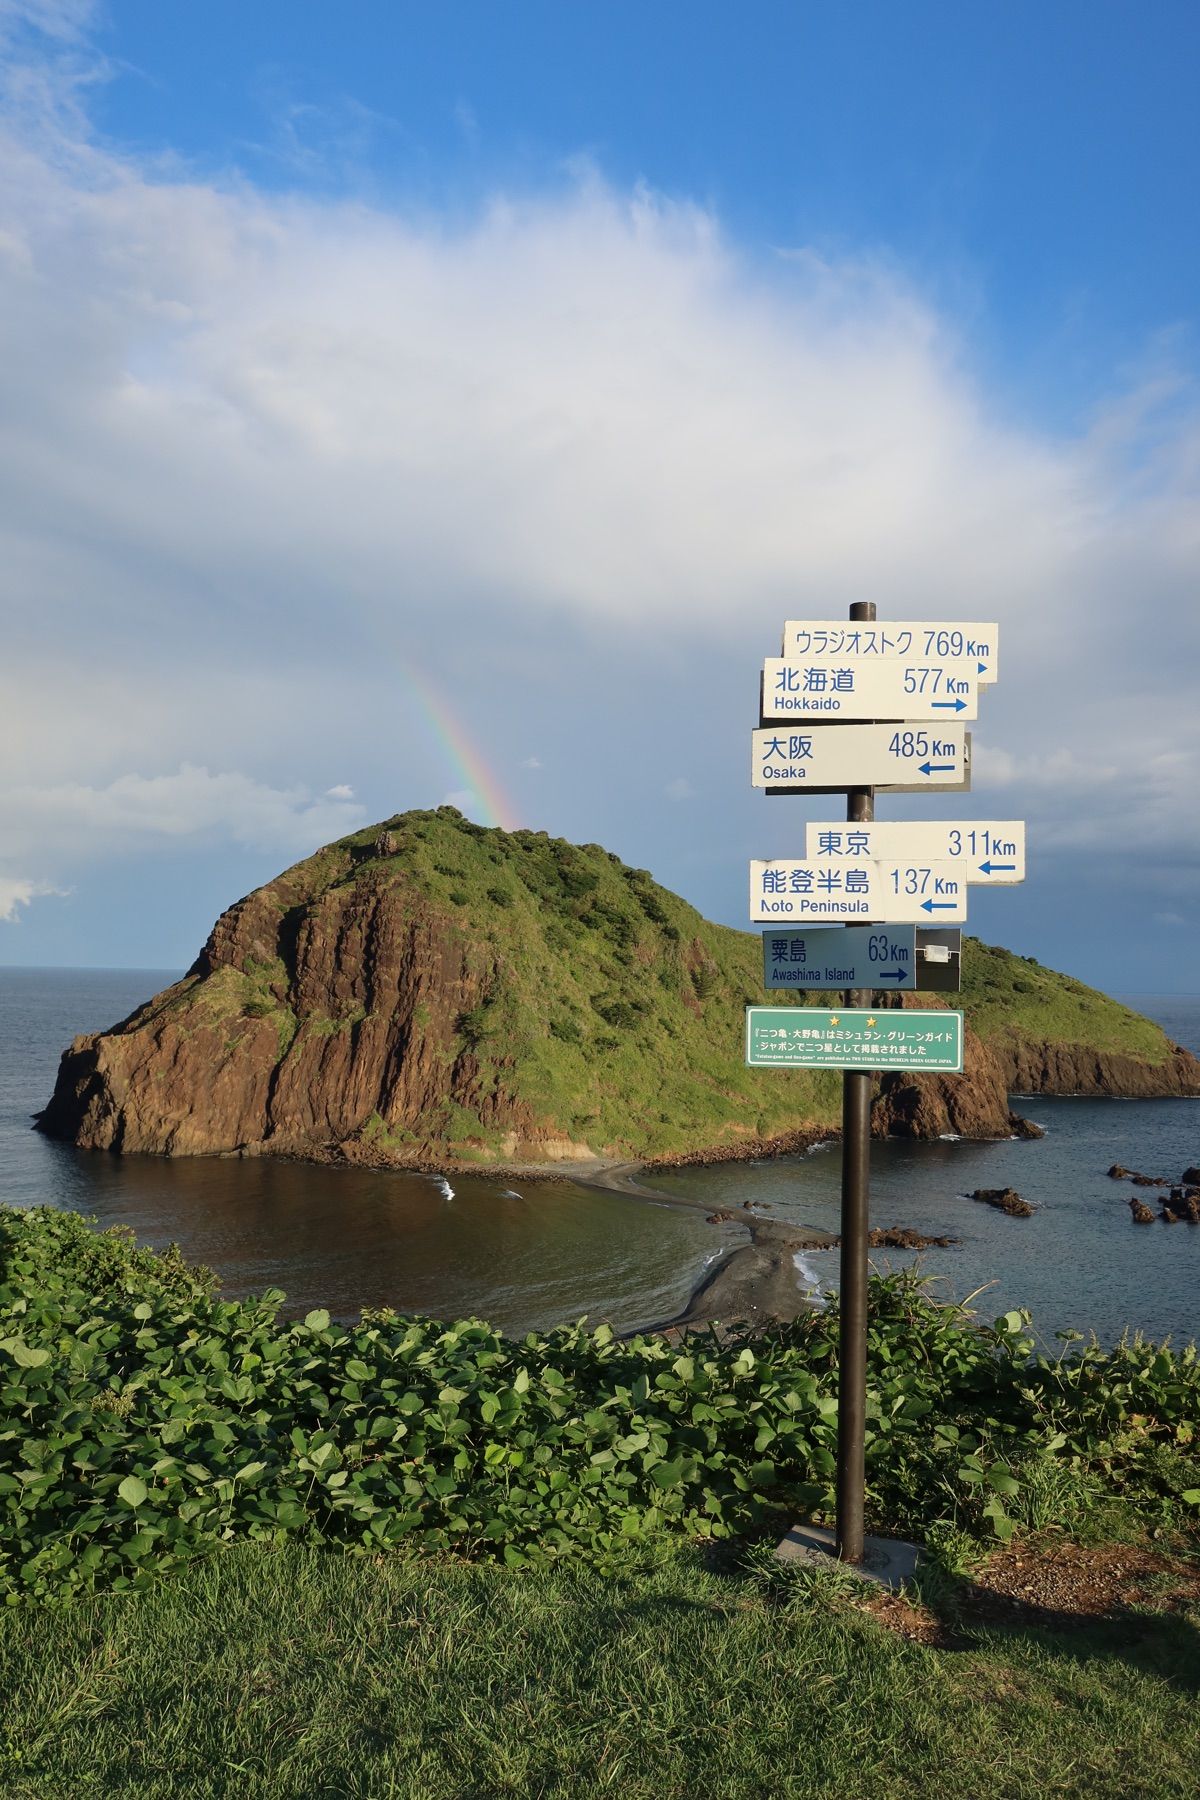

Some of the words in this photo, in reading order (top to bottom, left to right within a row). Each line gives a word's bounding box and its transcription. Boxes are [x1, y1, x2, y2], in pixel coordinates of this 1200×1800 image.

[796, 630, 913, 655] ウラジオストク
[775, 667, 855, 692] 北海道
[774, 697, 841, 710] Hokkaido
[762, 735, 814, 760] 大阪
[762, 766, 806, 779] Osaka
[817, 830, 871, 856] 東京
[761, 869, 870, 894] 能登半島
[761, 899, 793, 913] Noto
[801, 899, 869, 913] Peninsula
[771, 938, 807, 963] 粟島
[772, 967, 821, 981] Awashima
[825, 967, 855, 981] Island
